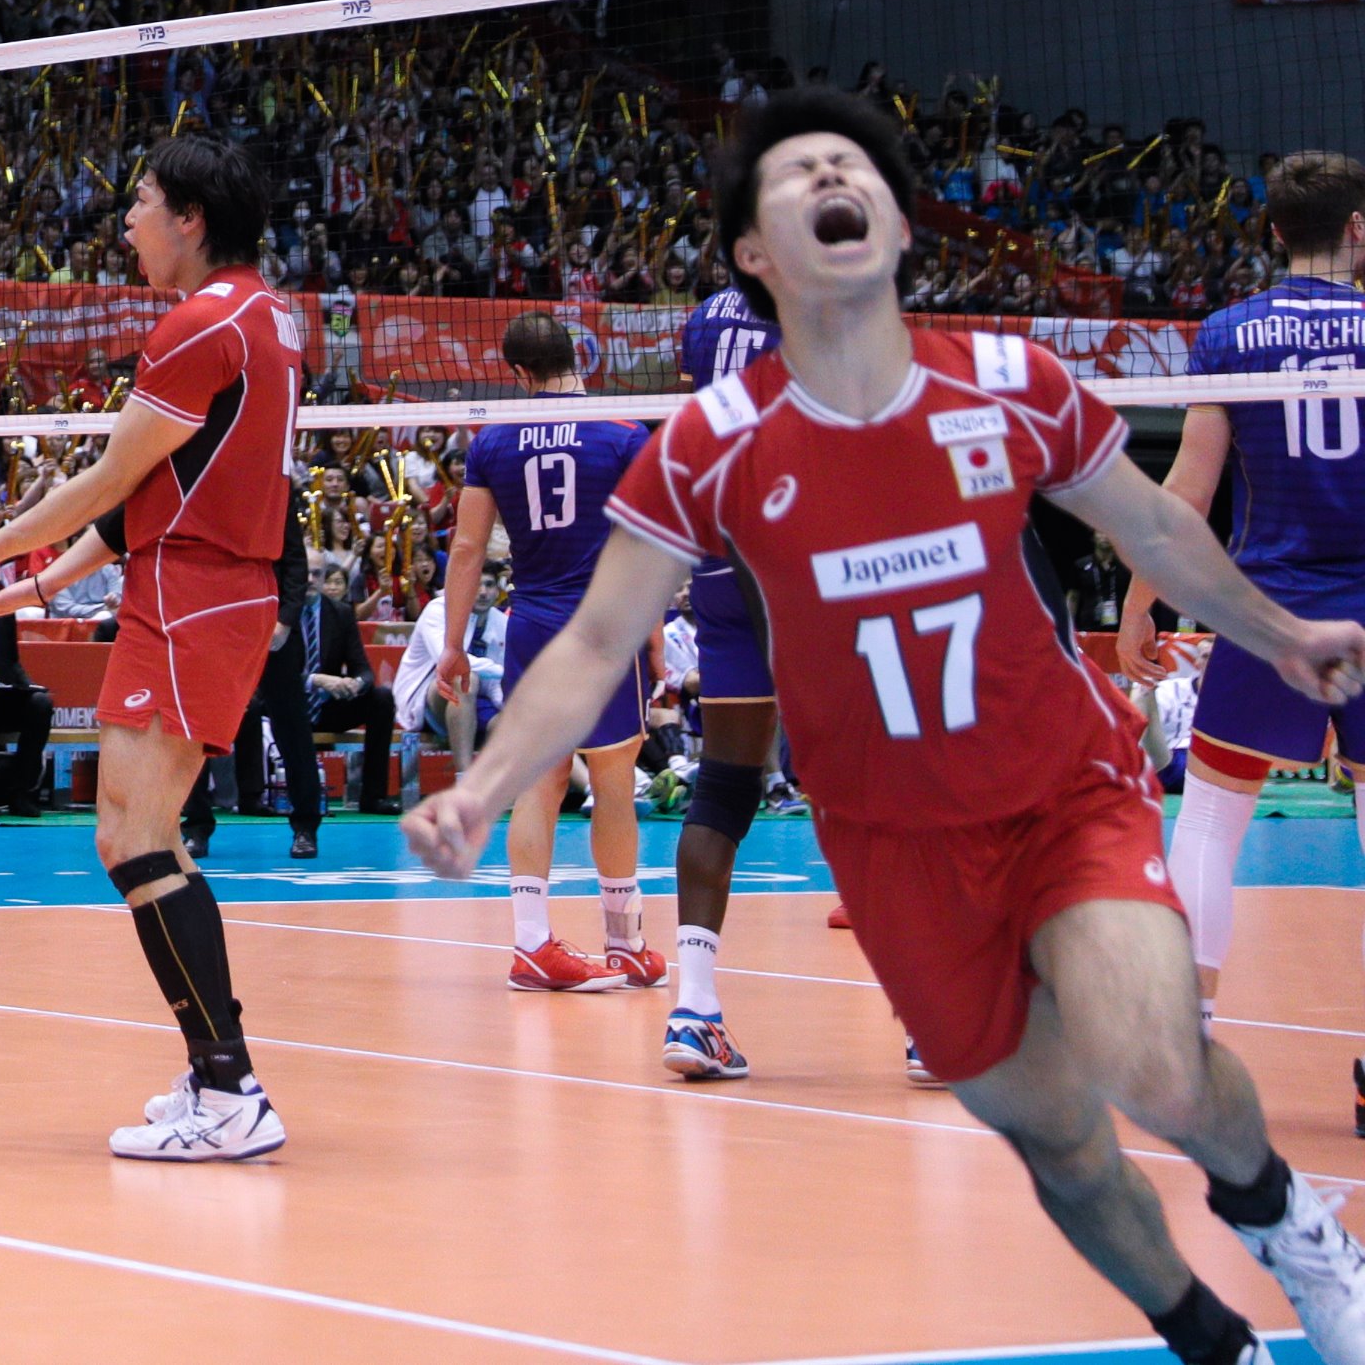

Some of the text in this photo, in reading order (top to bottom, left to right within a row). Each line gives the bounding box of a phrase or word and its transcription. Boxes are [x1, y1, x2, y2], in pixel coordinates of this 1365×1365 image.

[342, 0, 371, 16] FIVB
[138, 26, 167, 42] FIVB
[1236, 315, 1365, 353] MARECH
[1302, 379, 1328, 390] FIVB
[1281, 354, 1360, 460] 10
[519, 422, 583, 452] PUJOL
[523, 451, 577, 532] 13
[970, 473, 1005, 493] JPN
[841, 538, 962, 586] Japanet
[855, 591, 985, 740] 17
[687, 937, 717, 955] erre
